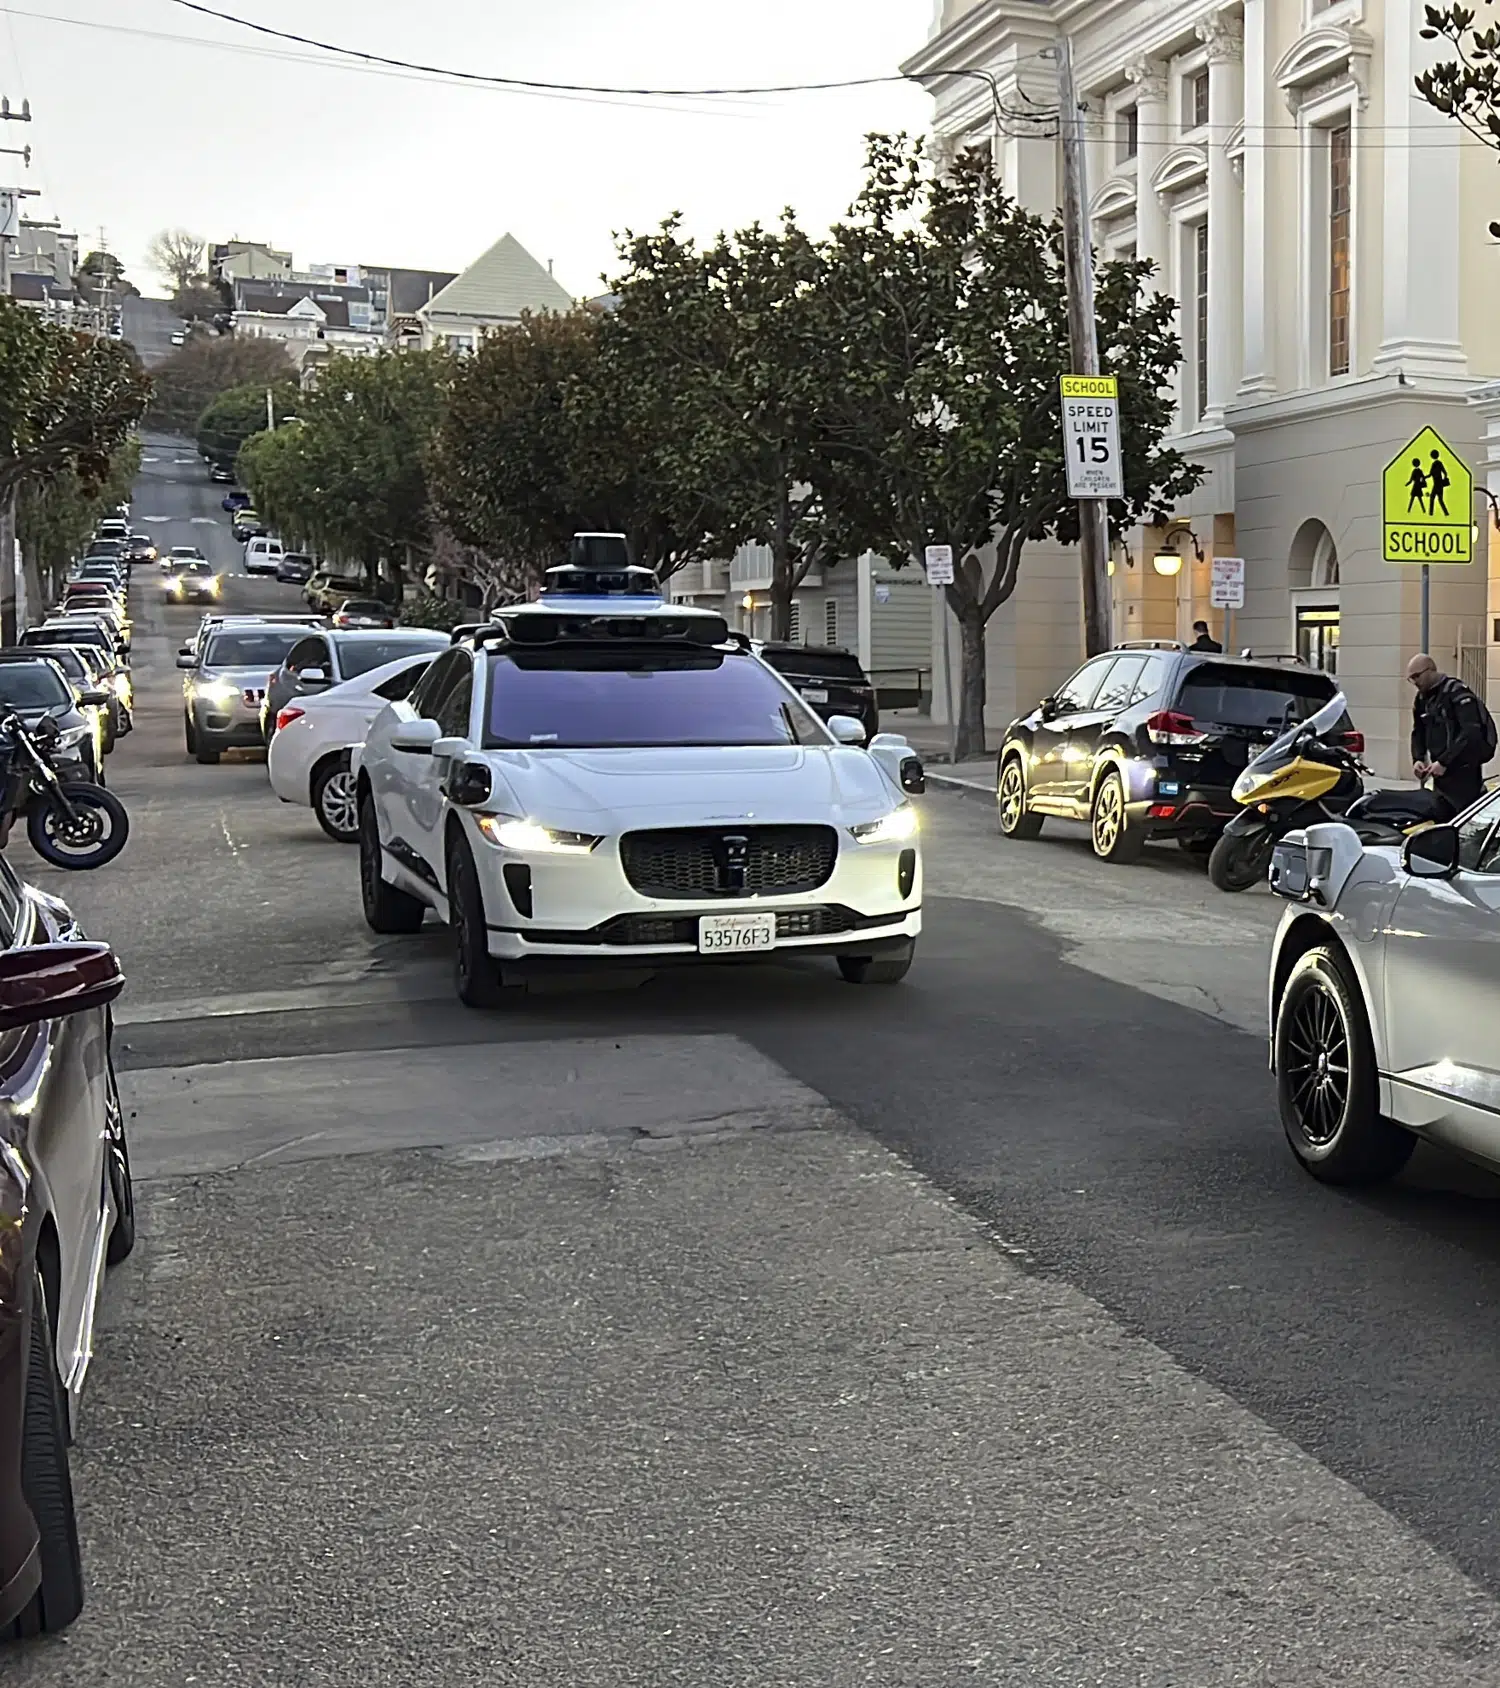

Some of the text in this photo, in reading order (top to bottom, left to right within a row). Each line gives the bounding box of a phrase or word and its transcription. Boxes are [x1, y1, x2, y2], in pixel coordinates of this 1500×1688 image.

[1064, 381, 1113, 394] SCHOOL
[1068, 406, 1113, 418] SPEED
[1073, 421, 1109, 433] LIMIT
[1076, 436, 1109, 463] 15
[1389, 531, 1467, 555] SCHOOL
[704, 927, 770, 948] 53576F3
